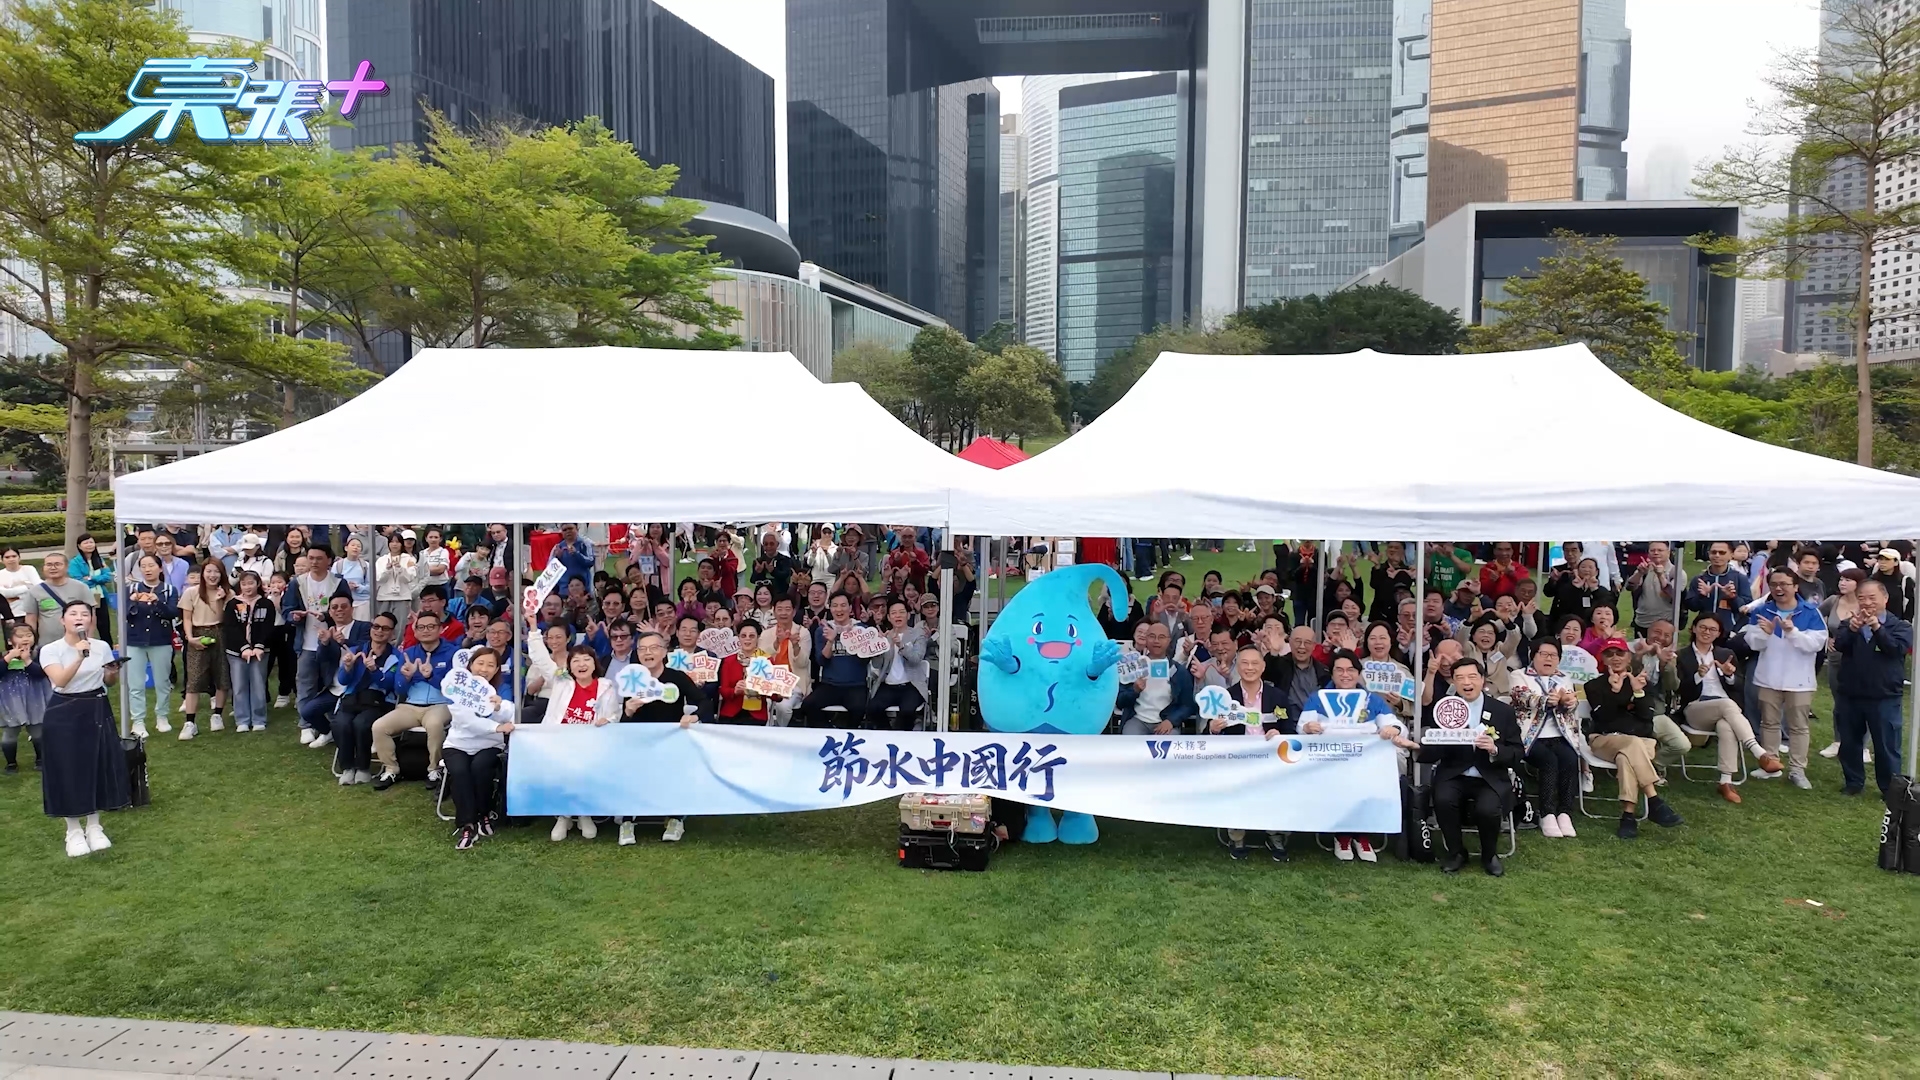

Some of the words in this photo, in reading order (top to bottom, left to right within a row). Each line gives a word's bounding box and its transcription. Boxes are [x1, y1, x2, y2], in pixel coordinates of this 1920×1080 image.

[842, 629, 862, 639] Save
[857, 630, 875, 642] Drop
[868, 641, 887, 653] Life
[621, 669, 646, 692] 水
[1200, 690, 1229, 715] 水
[1173, 740, 1207, 751] 水務署
[1307, 742, 1363, 753] 节水中国行
[1196, 753, 1226, 761] Supplies
[1228, 752, 1269, 761] Department
[818, 732, 1067, 801] 節水中國行
